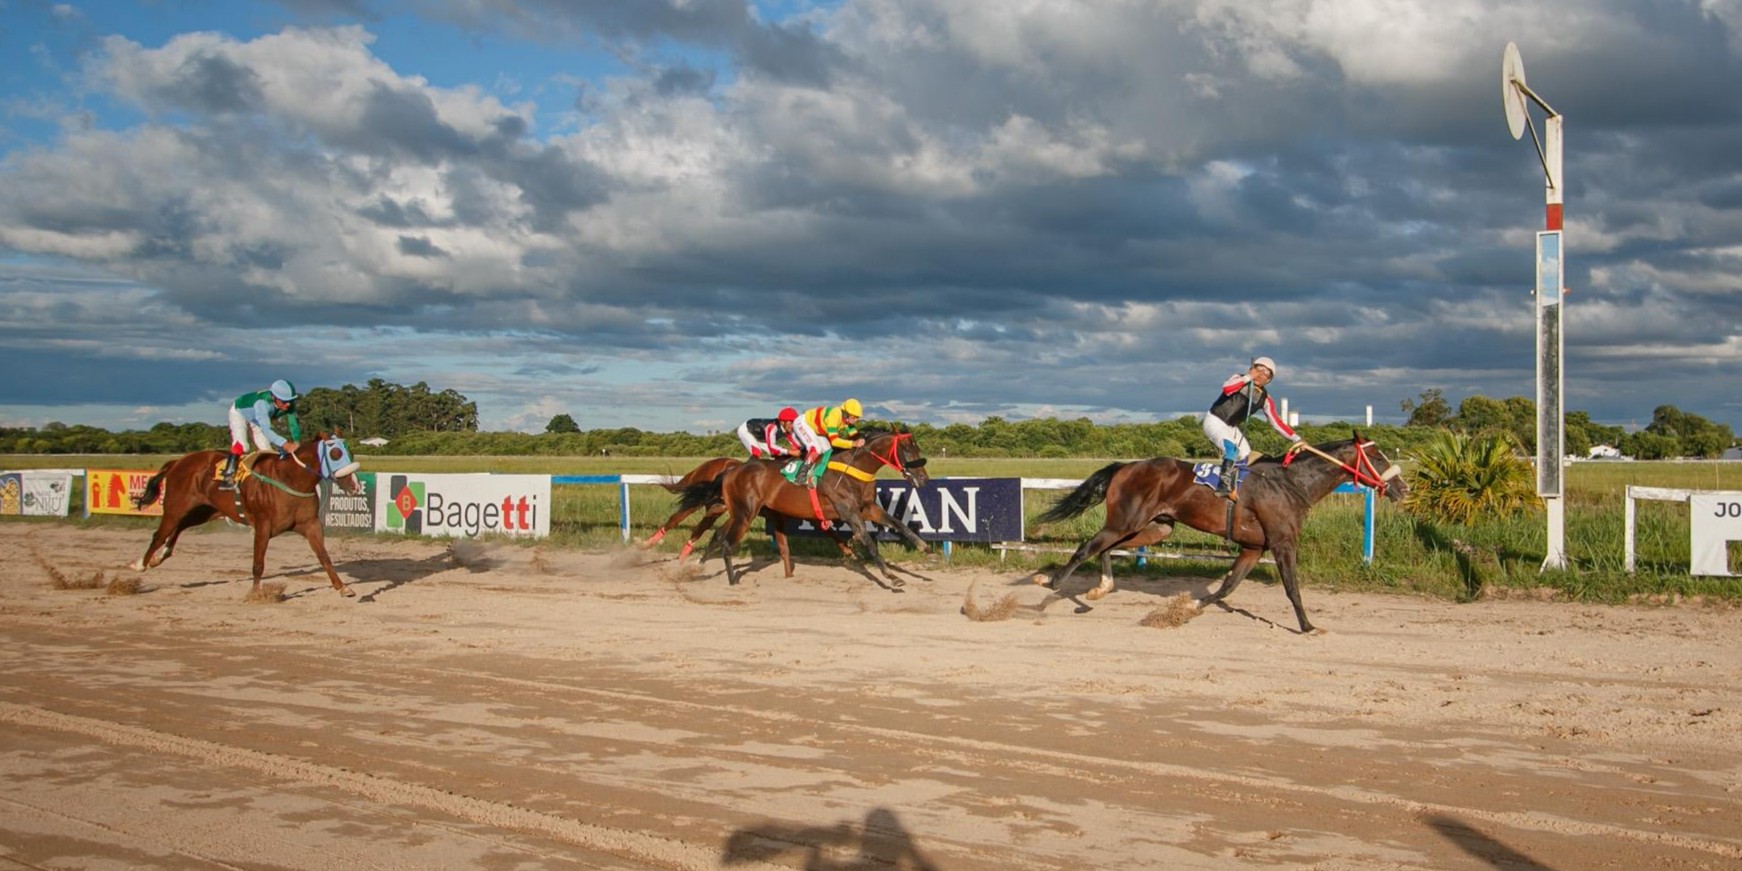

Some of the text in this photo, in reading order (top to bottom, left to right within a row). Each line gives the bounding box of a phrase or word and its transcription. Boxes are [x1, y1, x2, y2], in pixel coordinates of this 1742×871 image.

[330, 496, 370, 512] PRODUTOS,
[402, 495, 411, 511] B
[427, 493, 537, 537] Bagetti
[799, 487, 980, 534] VAN
